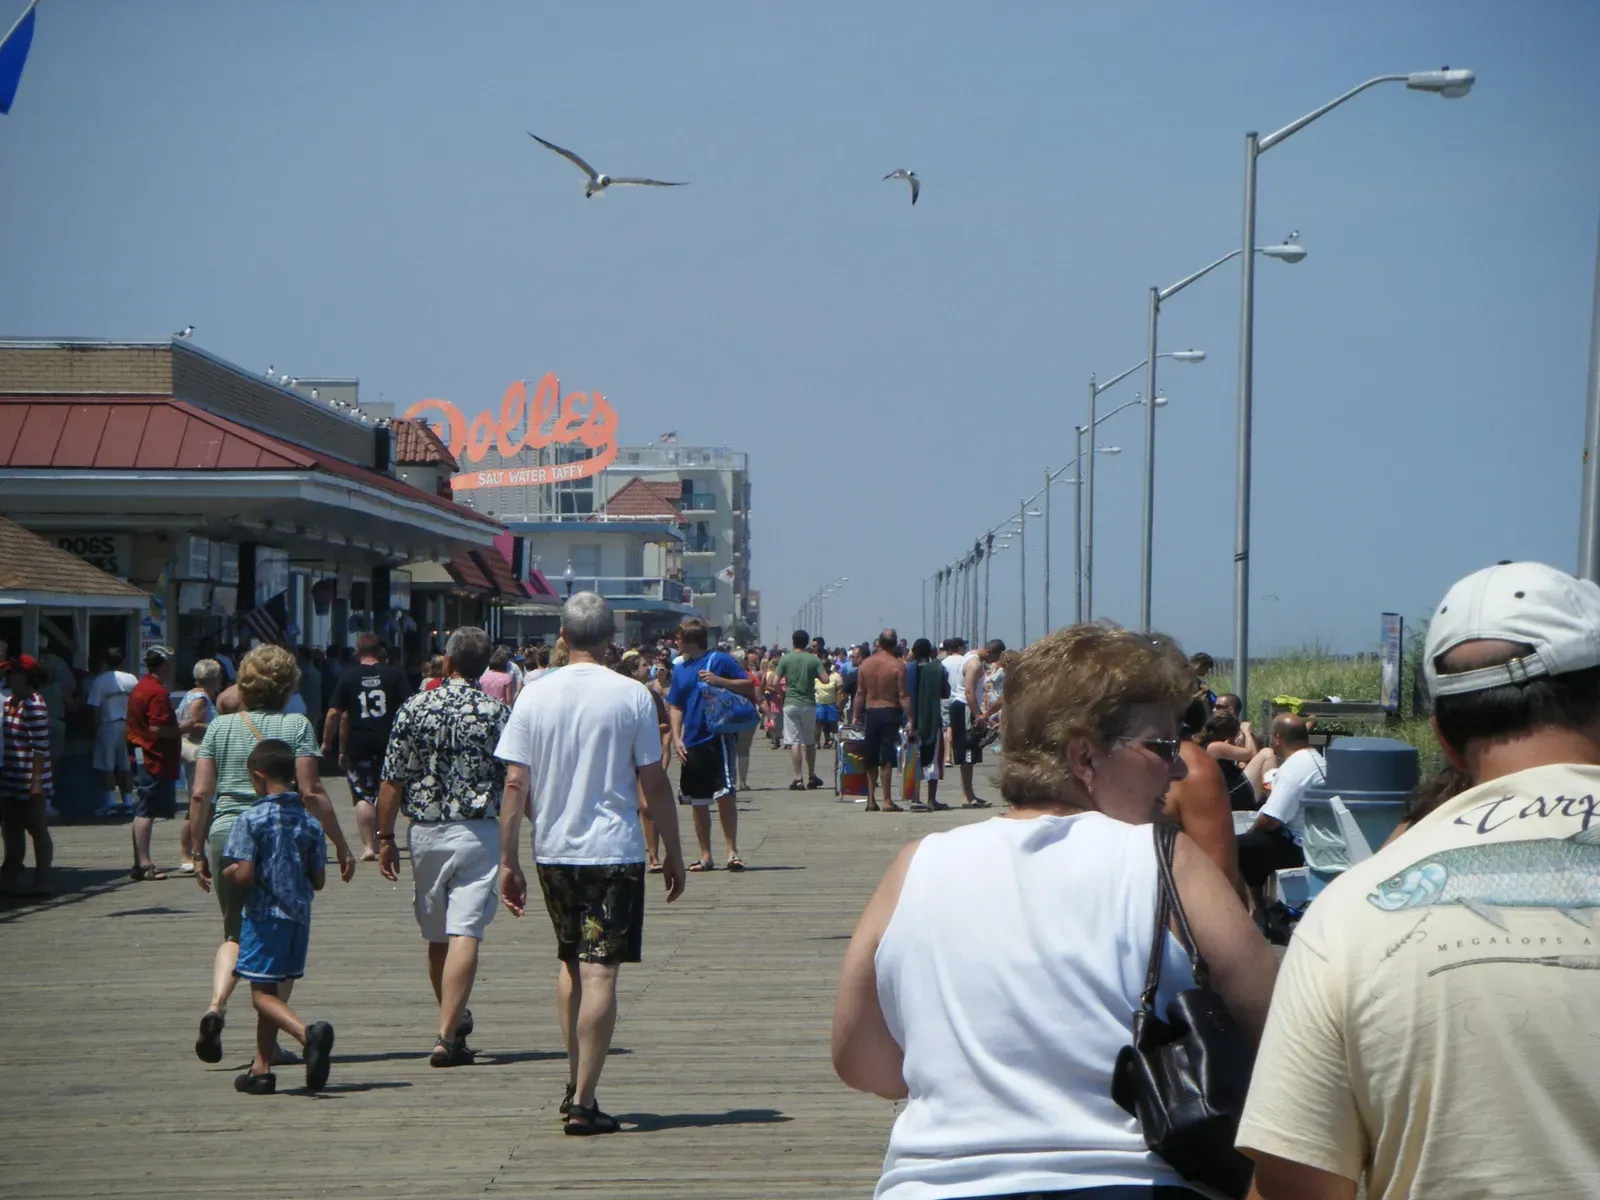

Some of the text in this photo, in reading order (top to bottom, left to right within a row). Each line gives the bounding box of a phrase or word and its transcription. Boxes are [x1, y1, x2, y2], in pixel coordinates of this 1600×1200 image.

[478, 464, 584, 486] SALT WATER TAFFY
[58, 536, 115, 554] DOGS
[358, 689, 387, 718] 13
[1437, 936, 1562, 952] MEGALOPS
